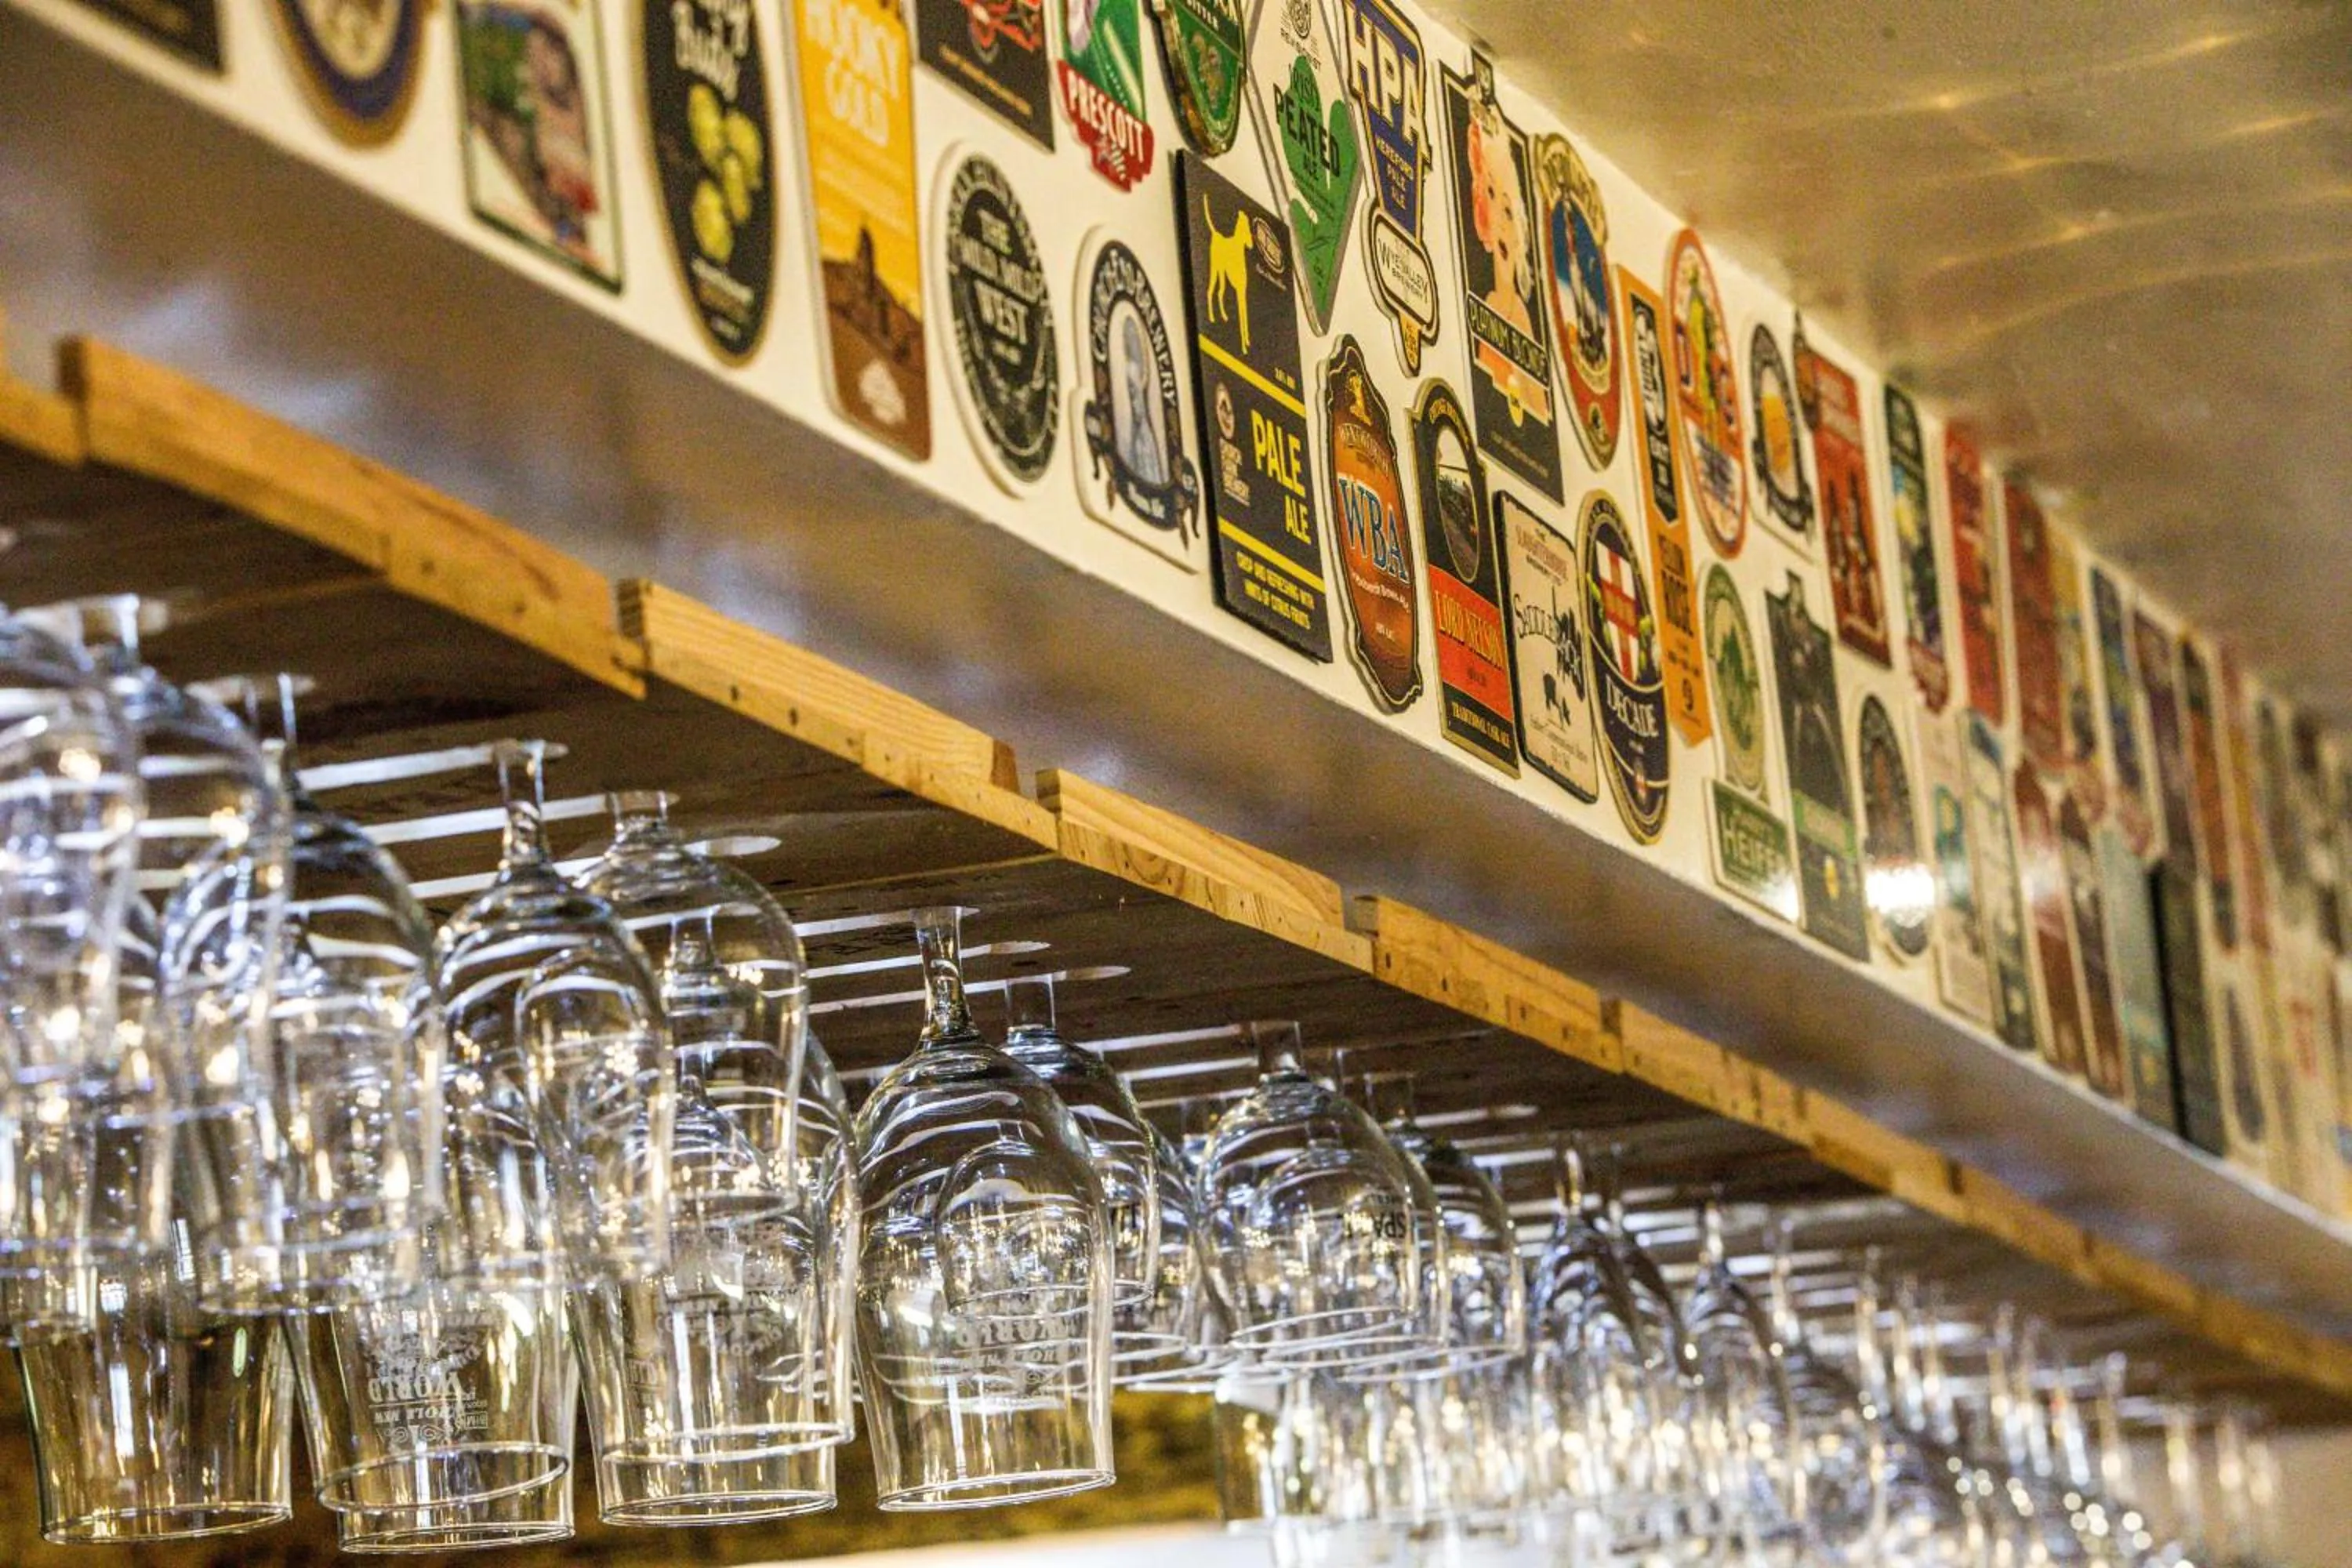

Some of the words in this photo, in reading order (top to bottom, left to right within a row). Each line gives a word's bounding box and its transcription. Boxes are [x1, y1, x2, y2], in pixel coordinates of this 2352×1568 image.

[1067, 68, 1144, 164] PRESCOTT
[1273, 83, 1340, 177] PEATED
[1346, 0, 1432, 166] HPA
[1251, 408, 1306, 498] PALE
[1284, 495, 1312, 545] ALE
[1337, 471, 1410, 585] WBA
[1606, 673, 1659, 737] DECADE
